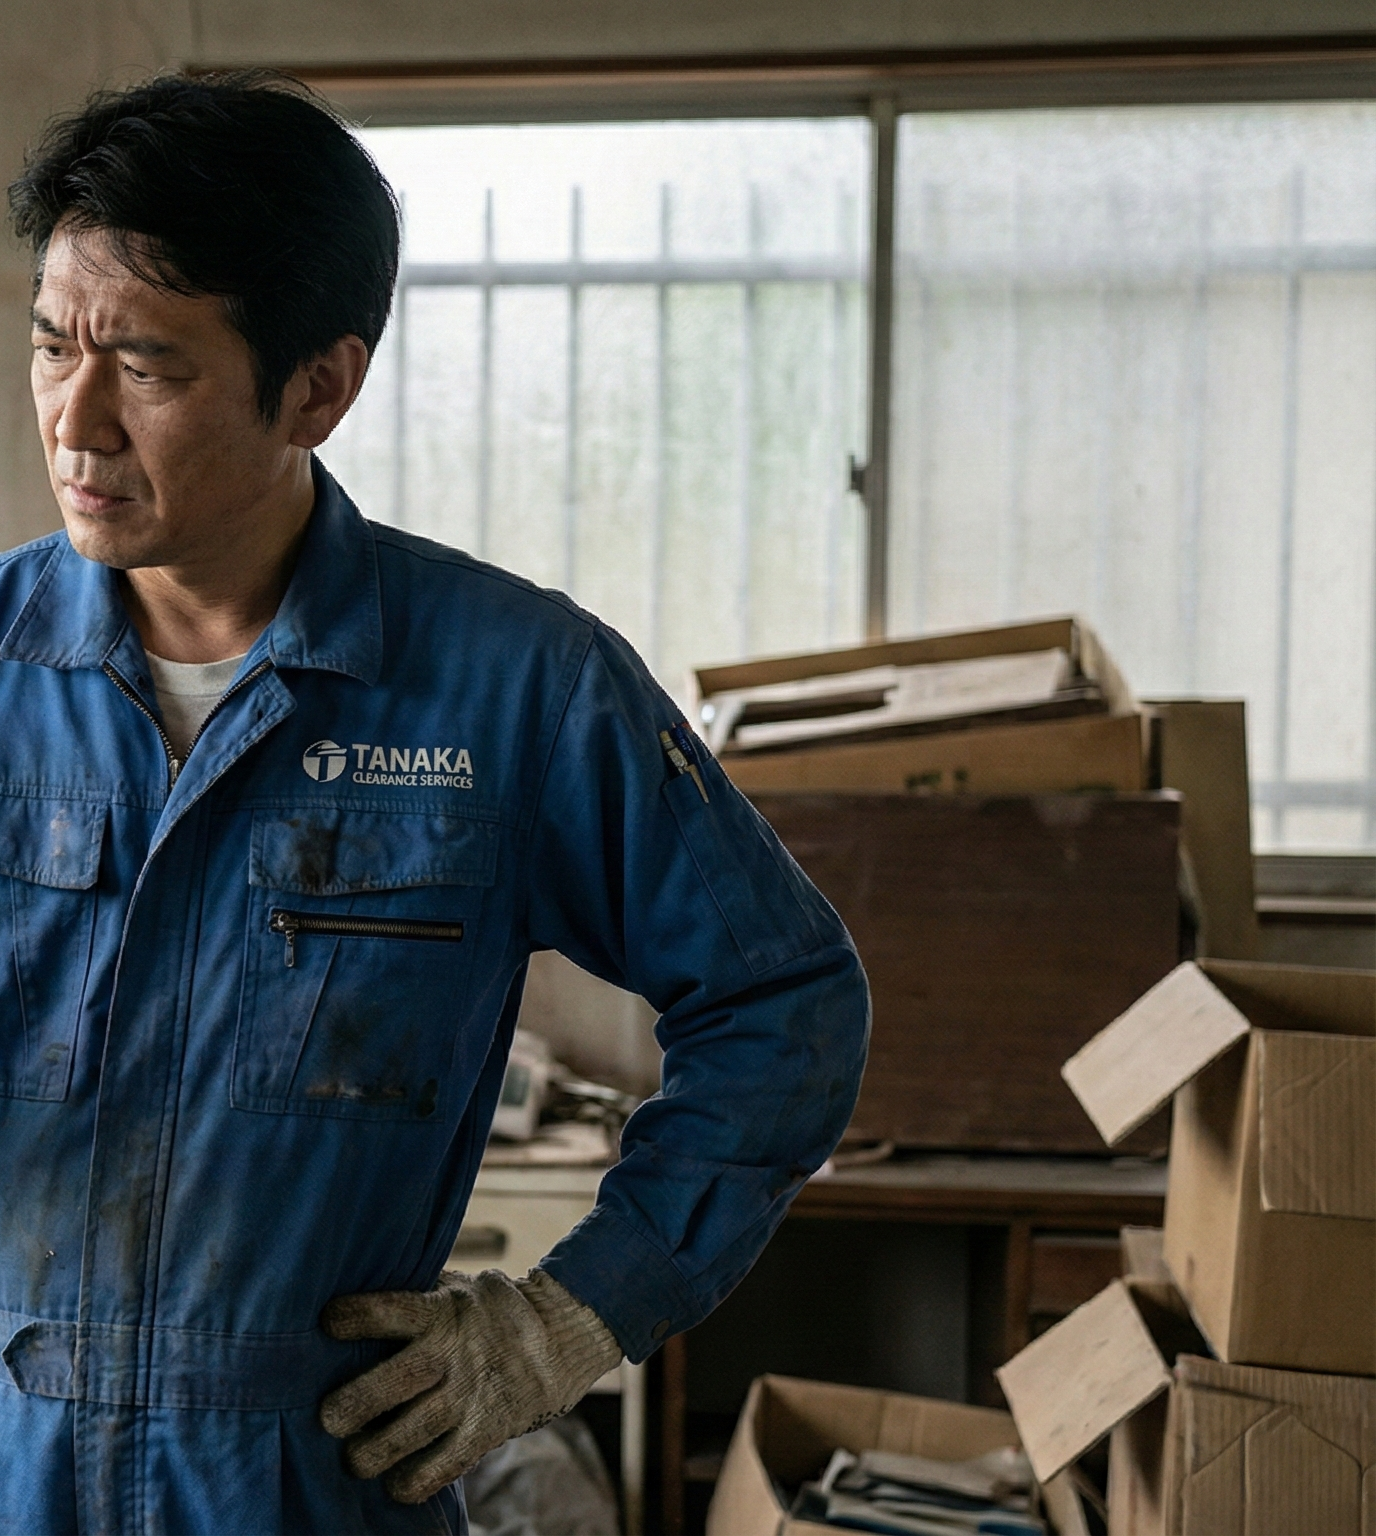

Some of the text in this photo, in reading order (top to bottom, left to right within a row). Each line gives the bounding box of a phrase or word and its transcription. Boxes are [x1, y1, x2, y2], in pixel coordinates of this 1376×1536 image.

[352, 744, 473, 774] TANAKA
[352, 772, 473, 789] CLEARANCE SERVICES
